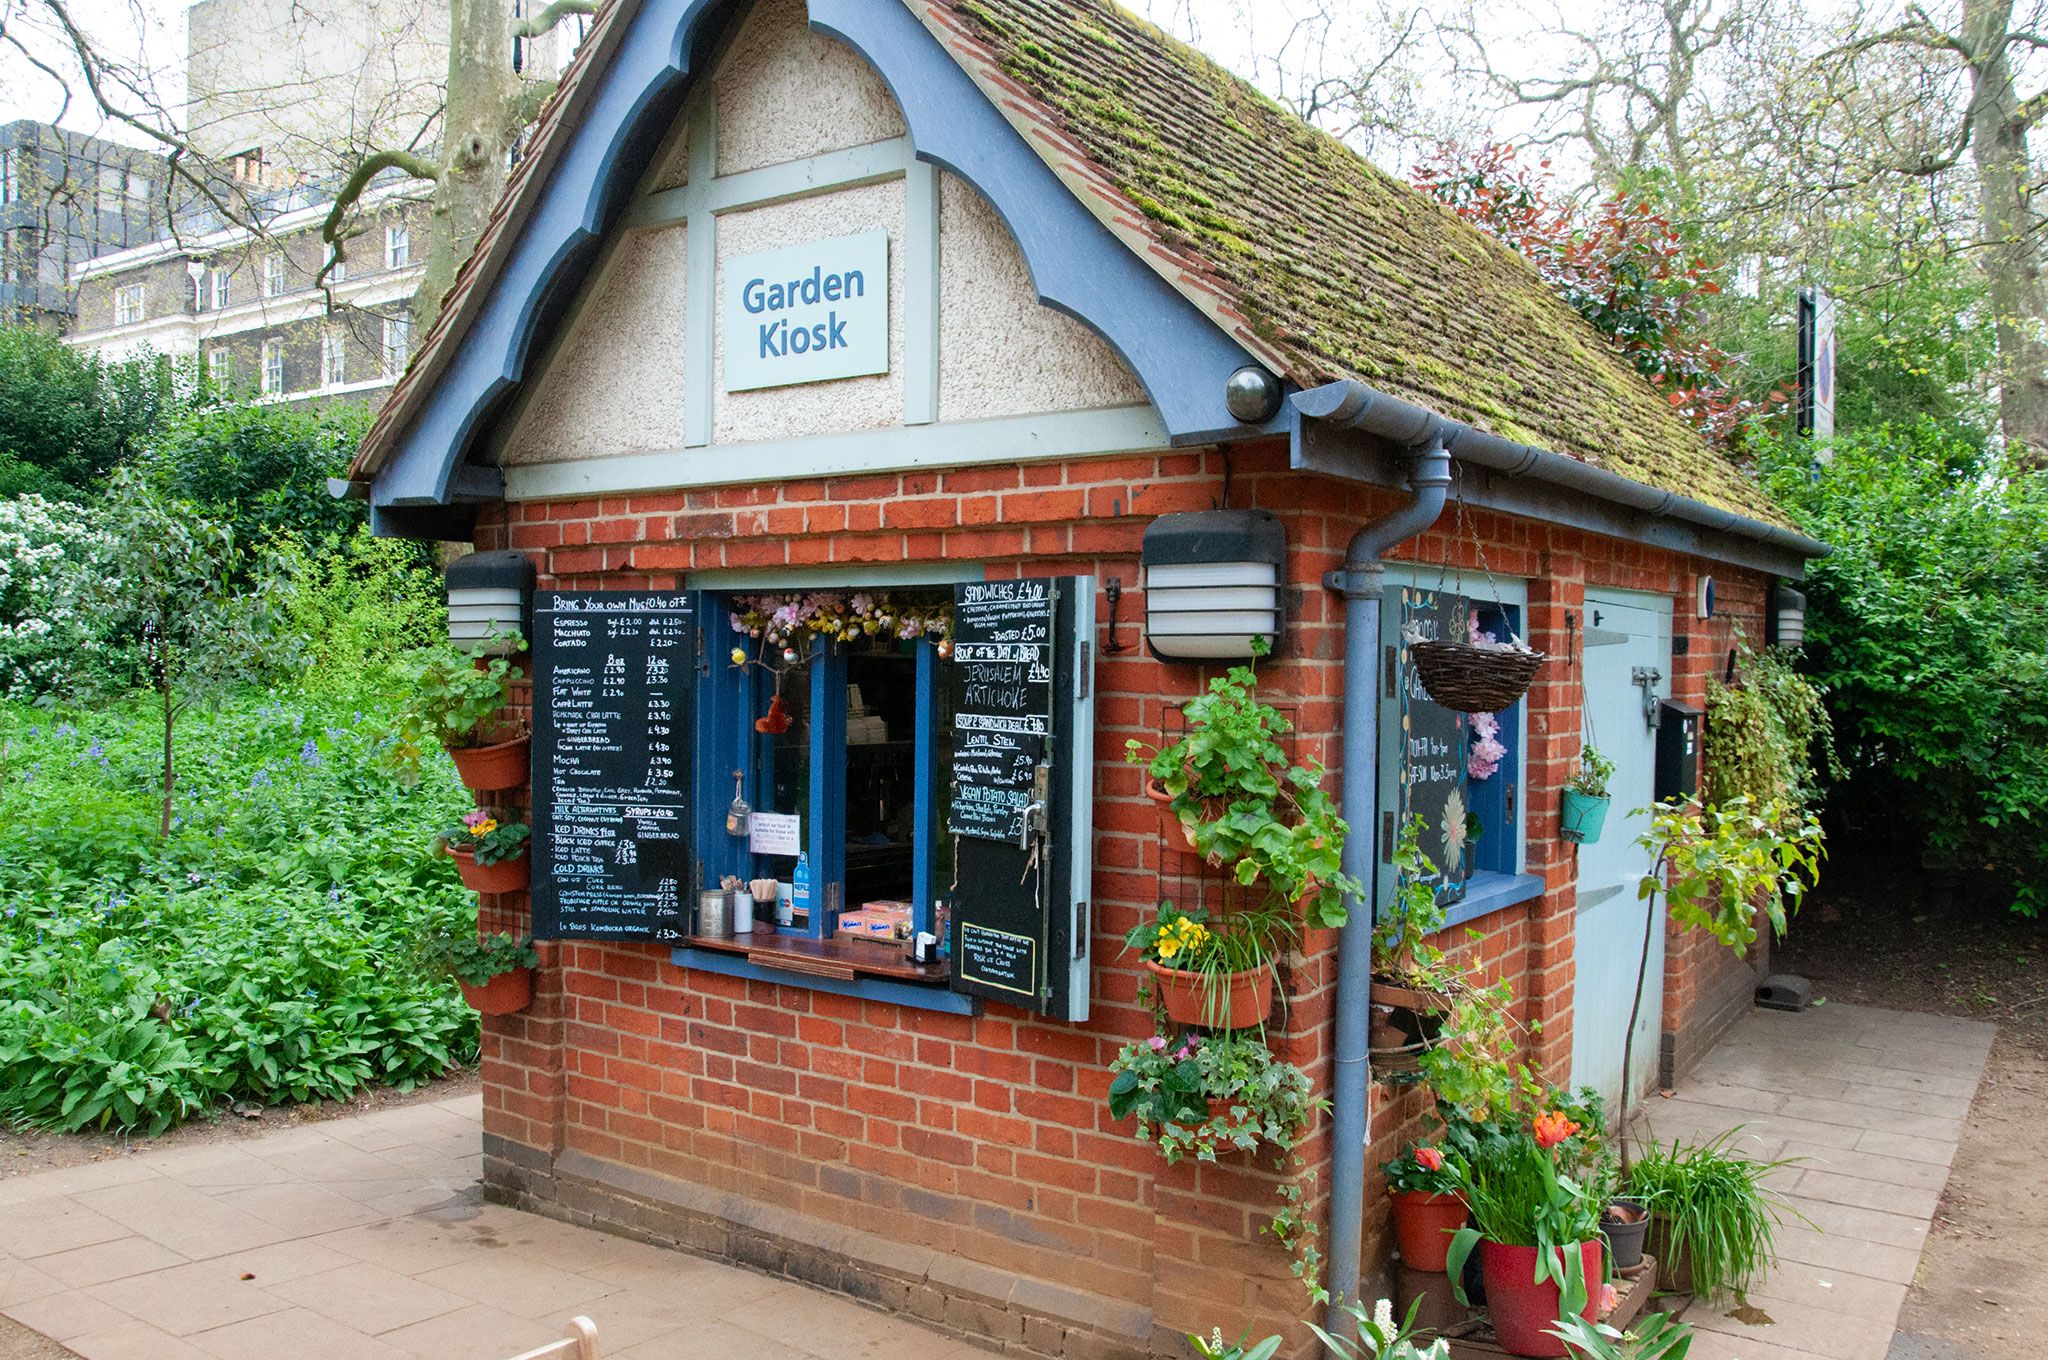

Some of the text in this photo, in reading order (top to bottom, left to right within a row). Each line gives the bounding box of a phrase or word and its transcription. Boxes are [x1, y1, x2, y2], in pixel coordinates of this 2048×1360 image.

[743, 266, 864, 314] Garden
[759, 311, 848, 359] Kiosk
[965, 583, 1014, 603] SANDWICHES
[553, 595, 579, 611] BRING
[584, 597, 604, 611] YOUR
[607, 602, 626, 611] OWN
[553, 617, 589, 627] ESPRESSO
[554, 629, 591, 637] MACCHIATO
[1021, 624, 1046, 641] £5.00
[553, 639, 587, 647] CORTADO
[955, 645, 974, 660] SOUP
[996, 645, 1011, 660] DAY
[1019, 645, 1040, 660] BREAD
[553, 665, 591, 675] AMERICANO
[963, 664, 1021, 686] JERUSALEM
[552, 676, 595, 685] CAPPUCCINO
[964, 684, 1027, 710] ARTICHOKE
[993, 734, 1015, 747] STEW
[553, 755, 580, 765] MOCHA
[569, 768, 601, 776] CHOCOLATE
[959, 785, 1029, 808] VEGAN POTATO SALAD
[554, 825, 571, 834] ICED
[553, 863, 605, 874] COLD DRINKS
